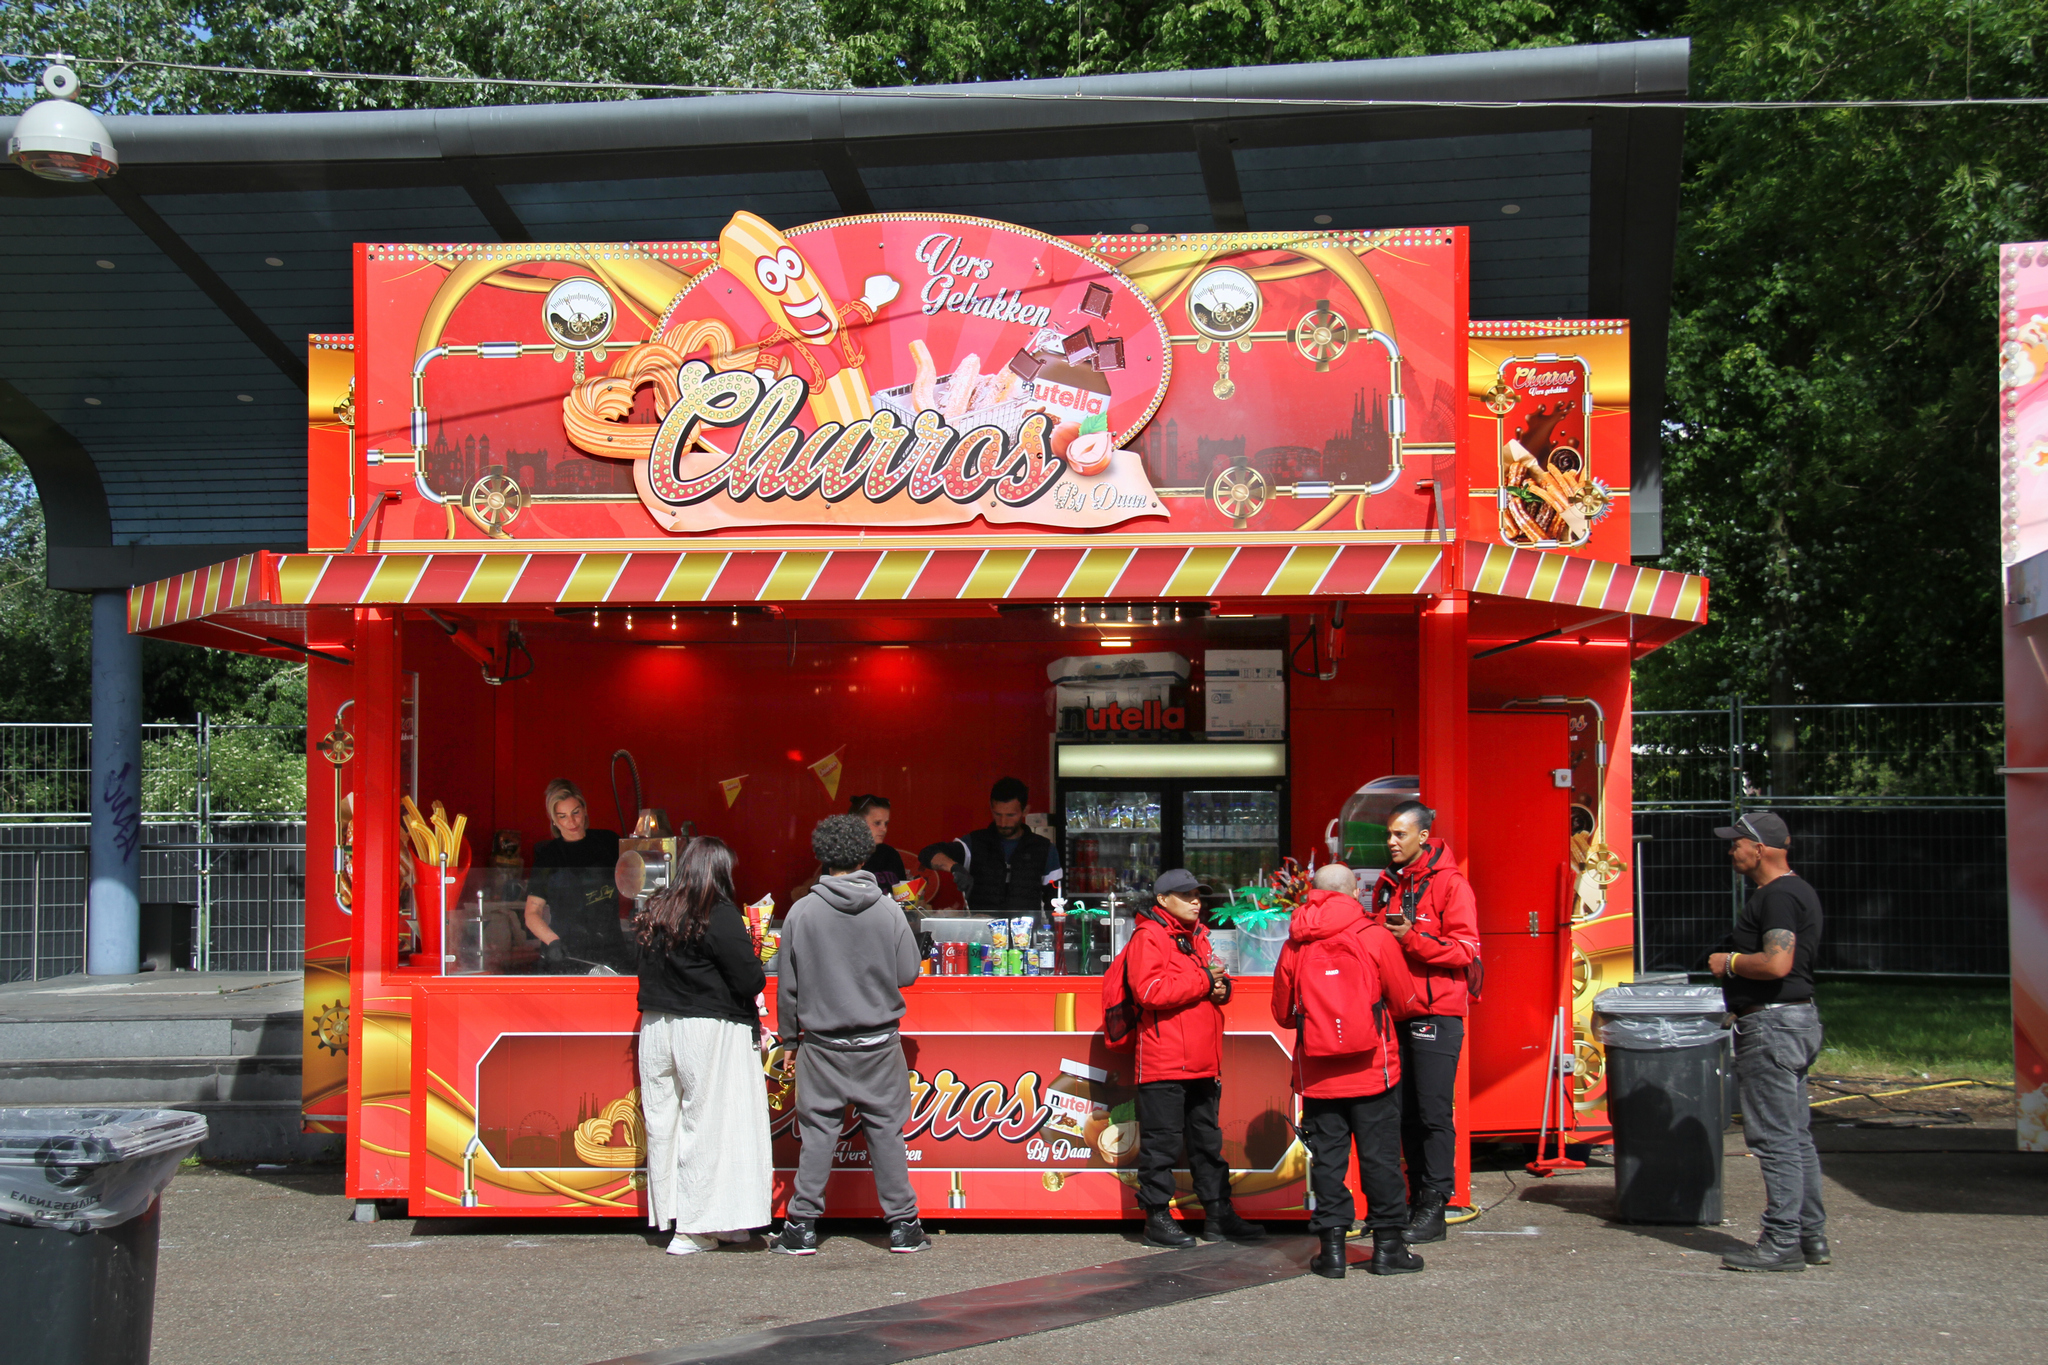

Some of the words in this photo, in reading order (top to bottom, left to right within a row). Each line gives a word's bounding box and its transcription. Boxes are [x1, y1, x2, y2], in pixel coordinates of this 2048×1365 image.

[914, 233, 993, 280] Vers
[920, 274, 1049, 328] Gebakken
[1513, 366, 1577, 389] Churros
[1022, 380, 1103, 415] nutella
[649, 359, 1066, 506] Churros
[1053, 480, 1090, 511] By
[1090, 482, 1148, 511] Daan
[1062, 700, 1185, 731] nutella
[1026, 1138, 1050, 1165] By
[1051, 1138, 1092, 1161] Daan
